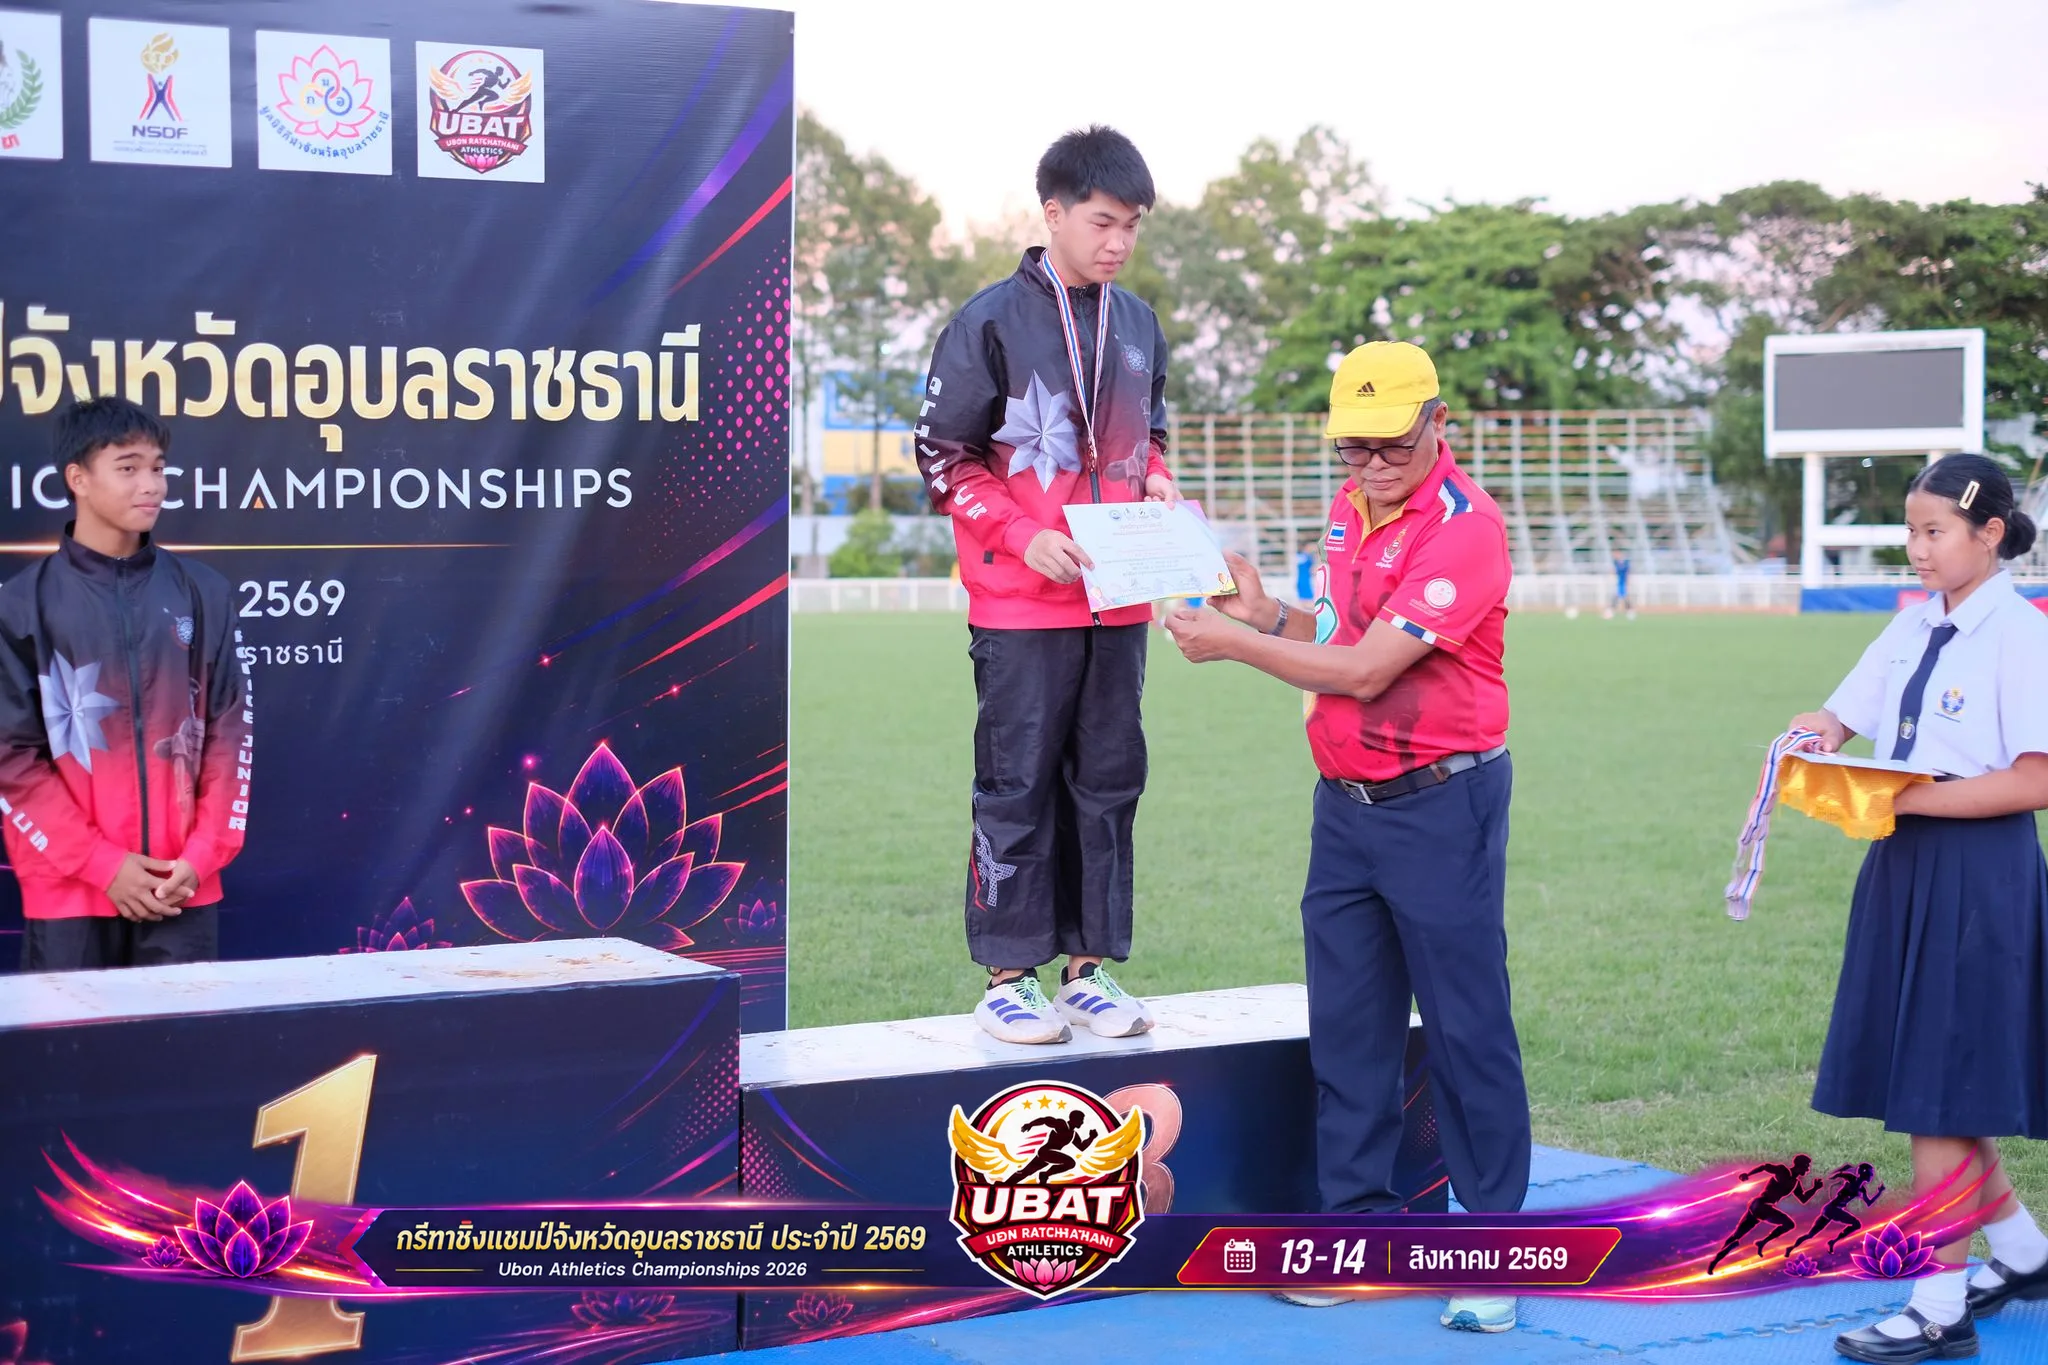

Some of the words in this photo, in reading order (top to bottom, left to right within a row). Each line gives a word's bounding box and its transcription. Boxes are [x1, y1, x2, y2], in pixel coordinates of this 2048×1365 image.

[132, 124, 188, 140] NSDF
[438, 112, 525, 139] UBAT
[460, 146, 504, 155] ATHLETICS
[161, 467, 633, 510] CHAMPIONSHIPS
[239, 579, 346, 618] 2569
[228, 734, 254, 831] JUNIOR
[229, 1053, 377, 1364] 1
